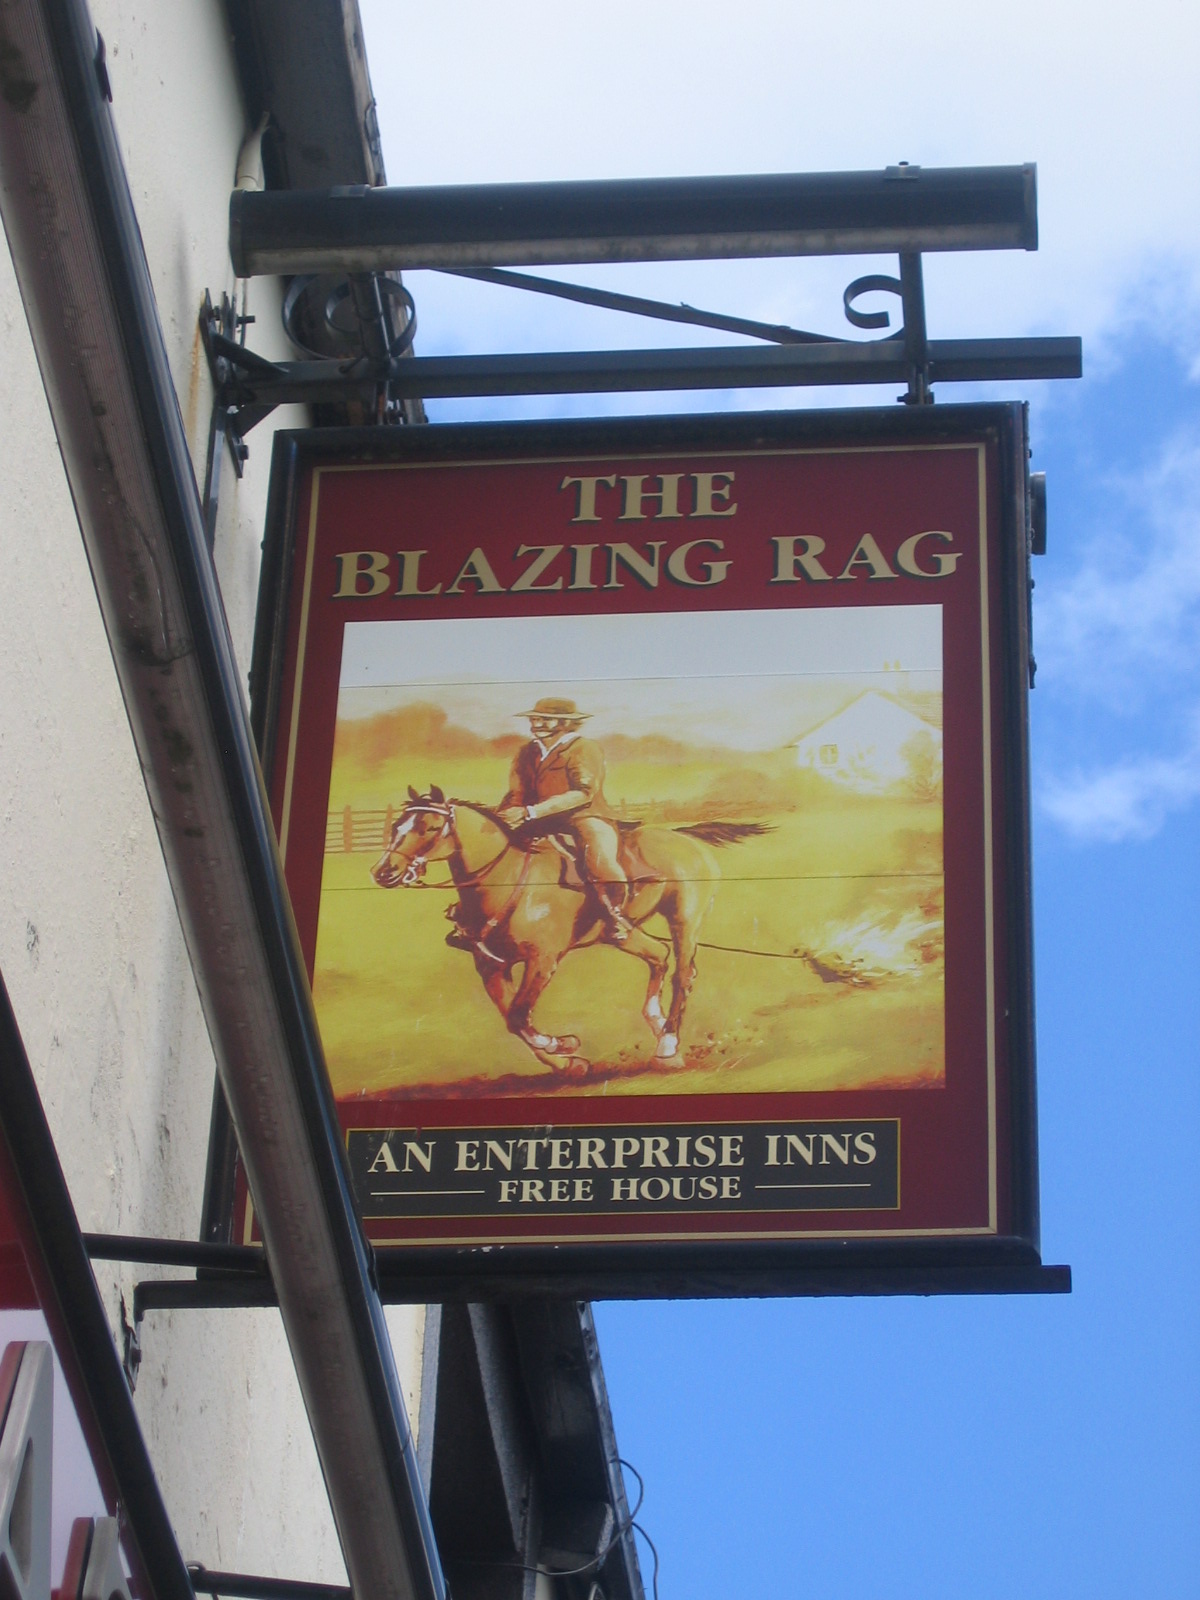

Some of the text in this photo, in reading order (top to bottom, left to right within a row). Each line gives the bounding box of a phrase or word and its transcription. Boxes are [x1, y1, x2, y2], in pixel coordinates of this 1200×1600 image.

[561, 471, 738, 522] THE
[332, 530, 963, 598] BLAZING RAG
[367, 1132, 878, 1174] AN ENTERPRISE INNS
[498, 1176, 742, 1203] FREE HOUSE
